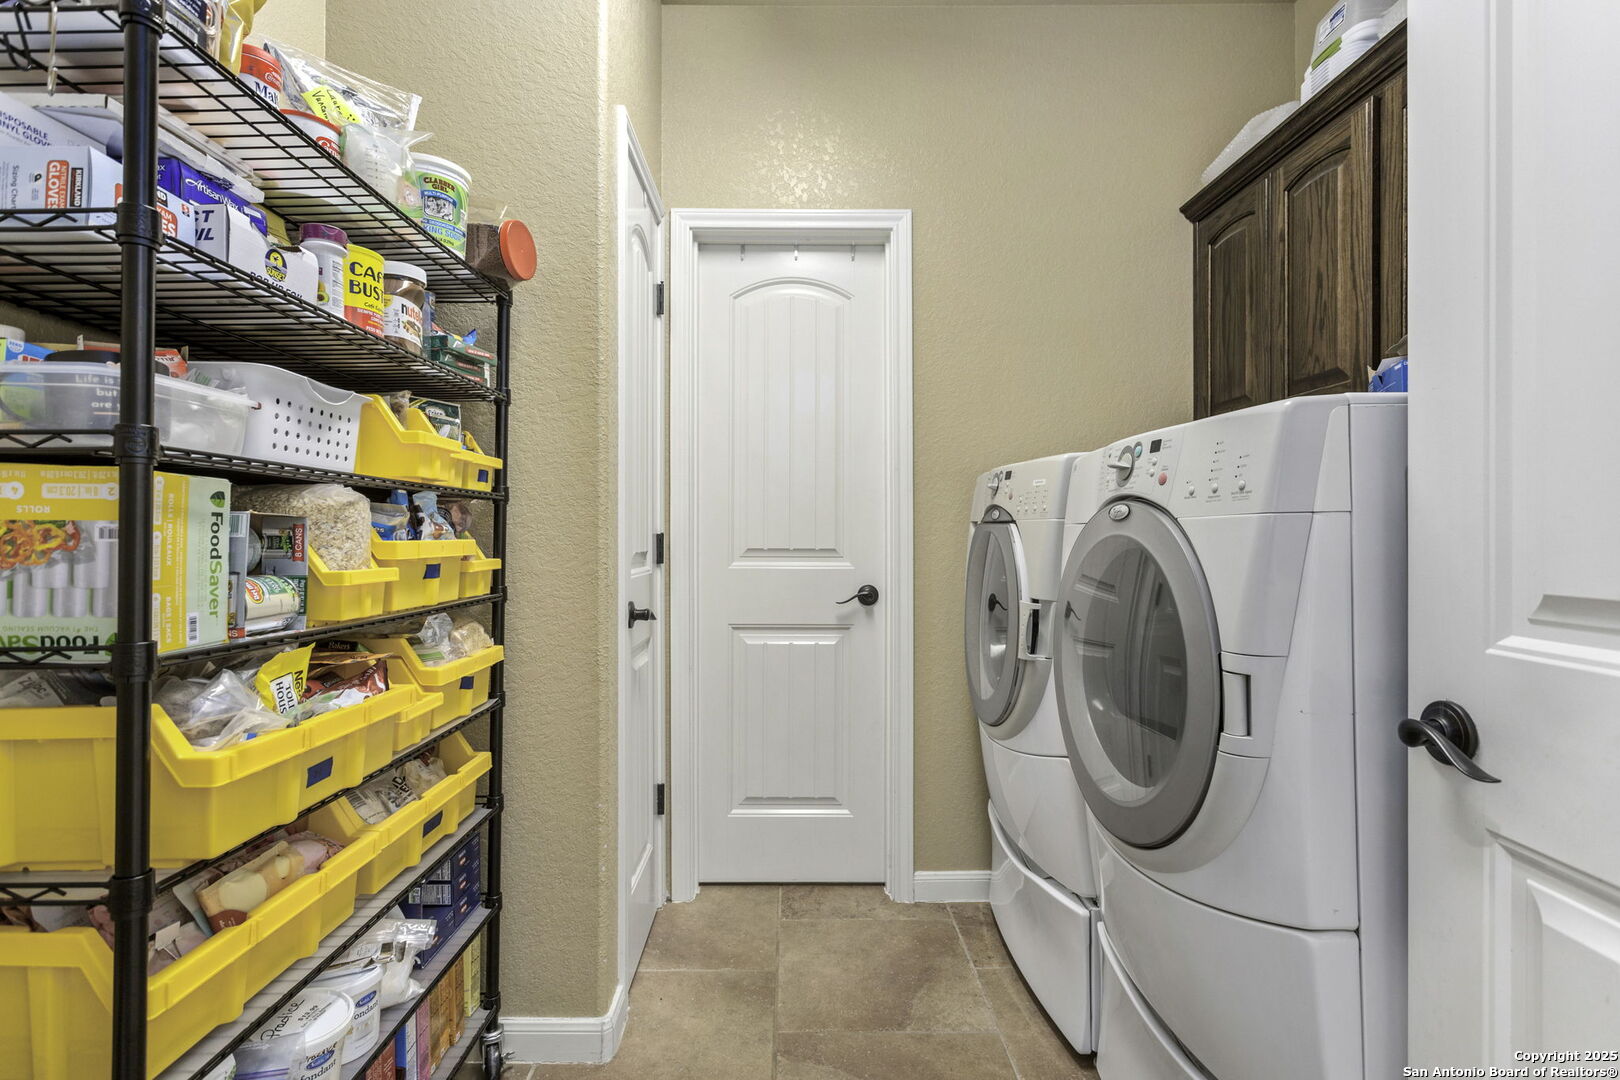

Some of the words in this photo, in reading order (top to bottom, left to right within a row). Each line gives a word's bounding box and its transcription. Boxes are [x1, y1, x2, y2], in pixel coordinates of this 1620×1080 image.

[0, 110, 49, 140] ISPOSABLE
[0, 119, 20, 135] INYL
[74, 169, 83, 207] KIRKLAND
[423, 176, 456, 193] CLABBER
[431, 183, 449, 194] GIRL
[75, 374, 100, 384] Life
[96, 388, 118, 397] but
[90, 401, 113, 409] are
[16, 505, 51, 513] ROLLS
[294, 527, 303, 551] CANS
[209, 511, 224, 618] FoodSaver
[275, 681, 288, 714] HOUS
[354, 999, 379, 1021] ondant
